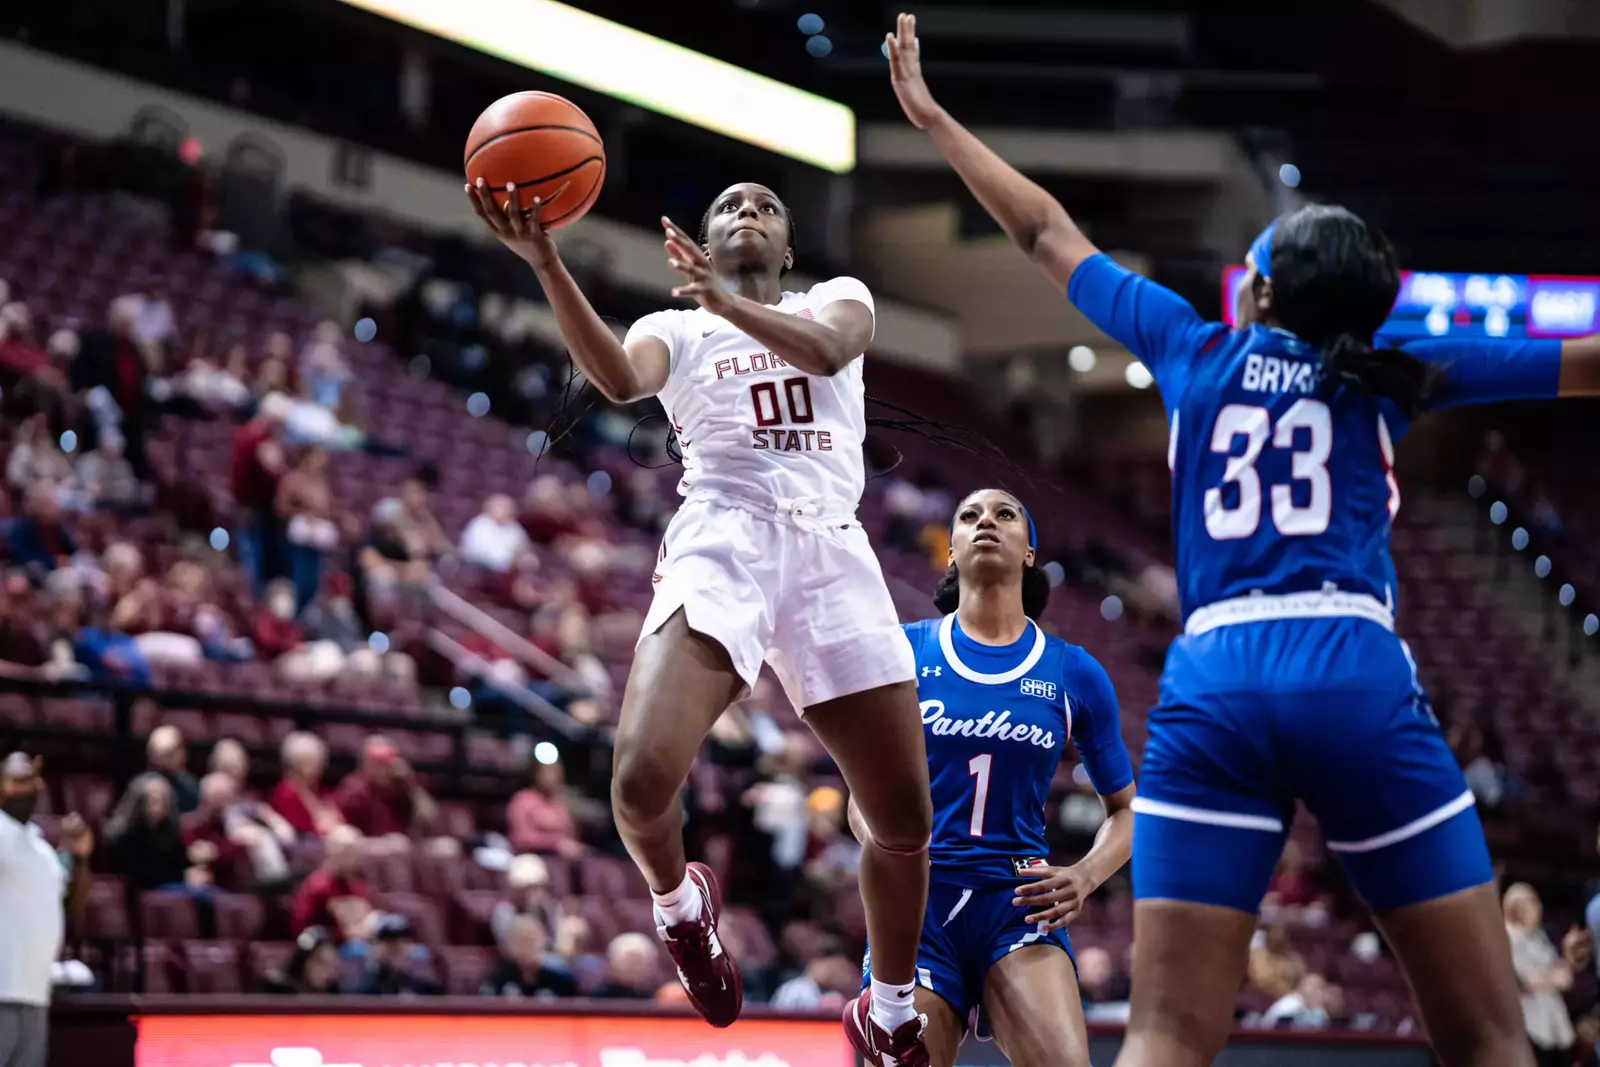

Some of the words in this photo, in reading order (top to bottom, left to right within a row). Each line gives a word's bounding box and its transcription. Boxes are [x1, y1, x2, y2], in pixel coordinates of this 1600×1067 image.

[715, 351, 787, 380] FLOR
[750, 376, 814, 427] 00
[752, 429, 832, 451] STATE
[1203, 397, 1333, 540] 33
[1020, 678, 1057, 700] SBC
[918, 699, 1056, 749] Panthers
[968, 753, 993, 838] 1
